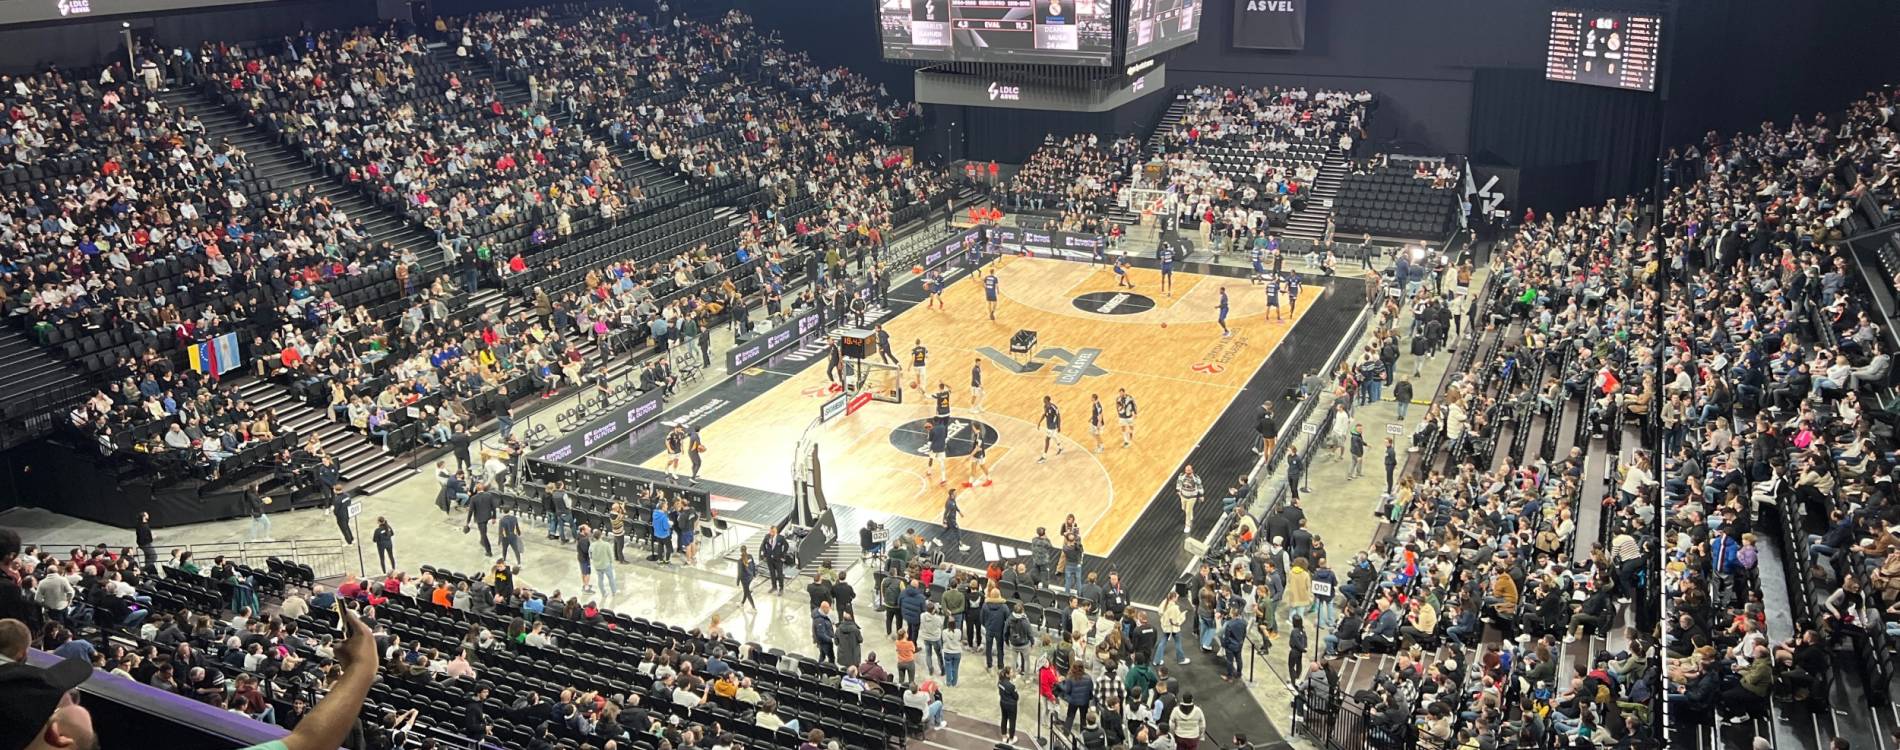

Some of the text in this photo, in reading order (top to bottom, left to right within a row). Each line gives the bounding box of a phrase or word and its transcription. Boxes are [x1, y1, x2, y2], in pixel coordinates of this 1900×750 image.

[1247, 0, 1294, 11] ASVEL
[999, 86, 1019, 94] LDLC
[1060, 353, 1093, 382] LDLC ASVEL
[873, 531, 888, 540] 020
[1314, 583, 1329, 592] 010
